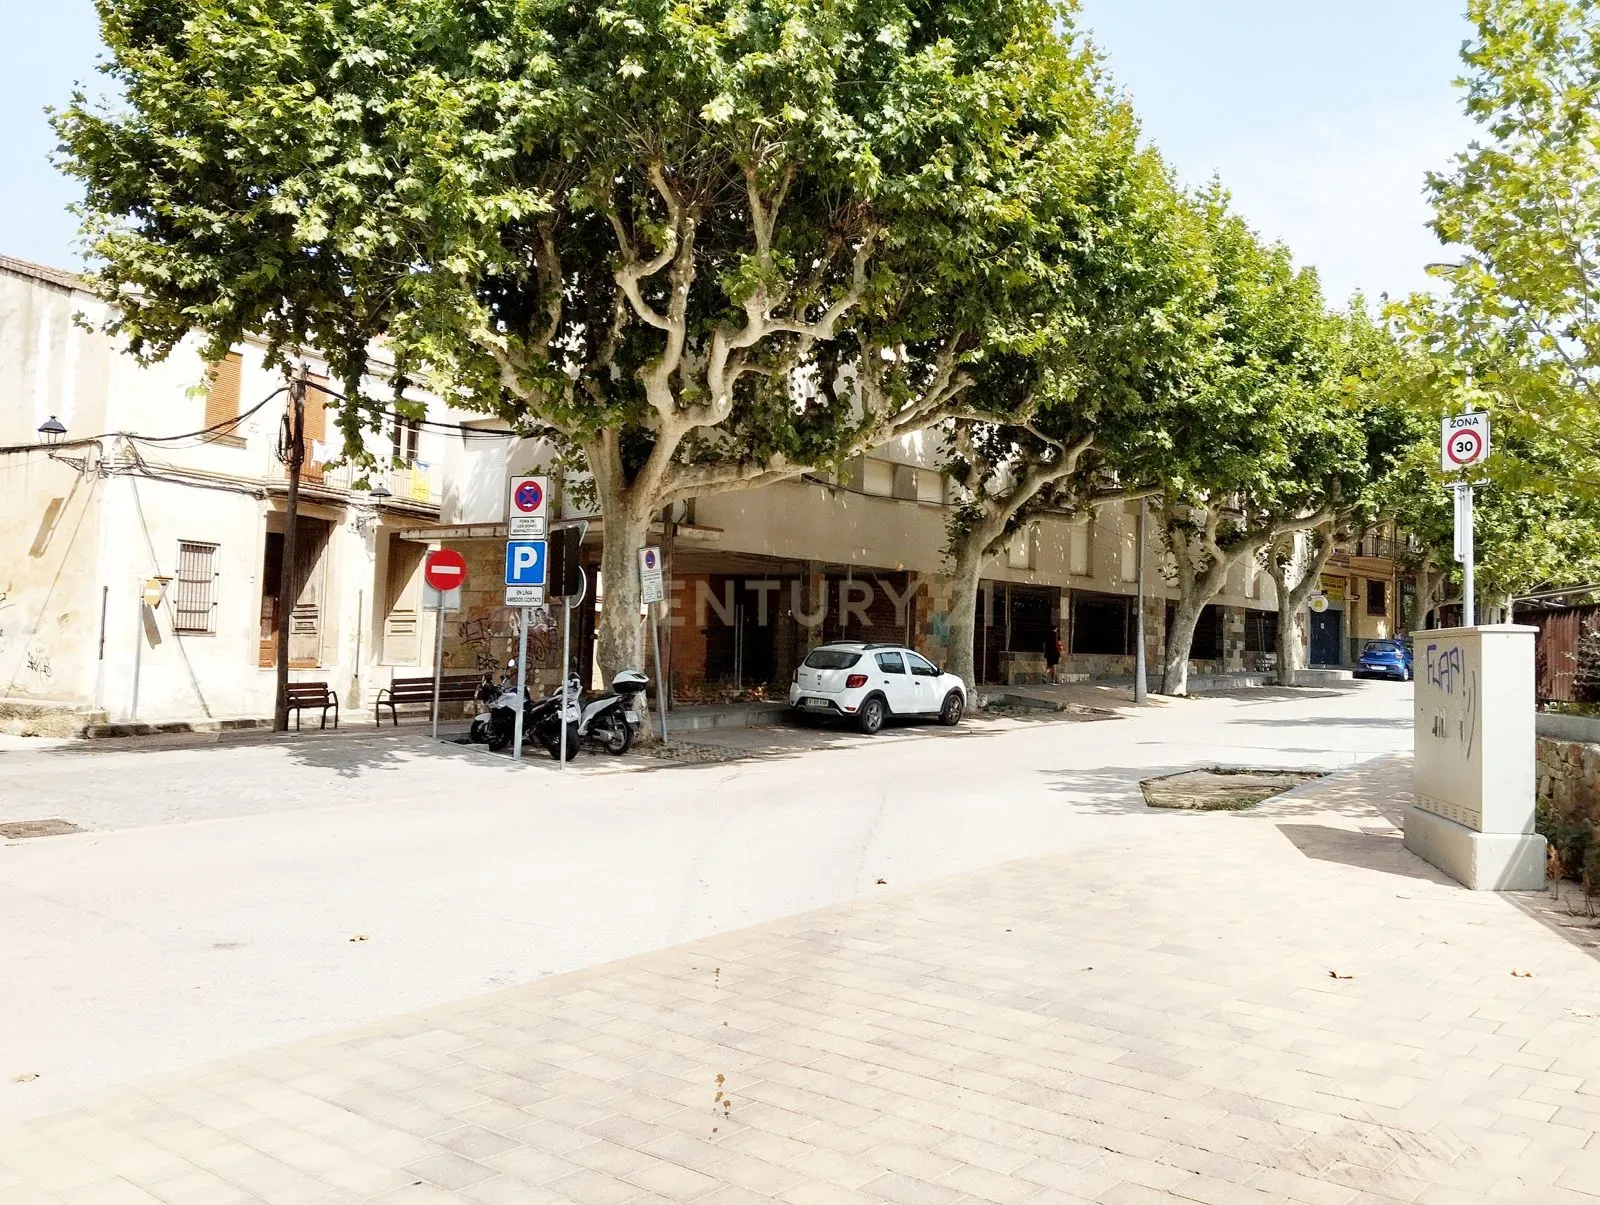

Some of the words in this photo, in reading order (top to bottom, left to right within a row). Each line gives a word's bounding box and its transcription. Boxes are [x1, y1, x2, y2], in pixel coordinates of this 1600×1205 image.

[1450, 417, 1479, 428] ZONA
[1456, 441, 1473, 453] 30
[513, 546, 538, 580] P
